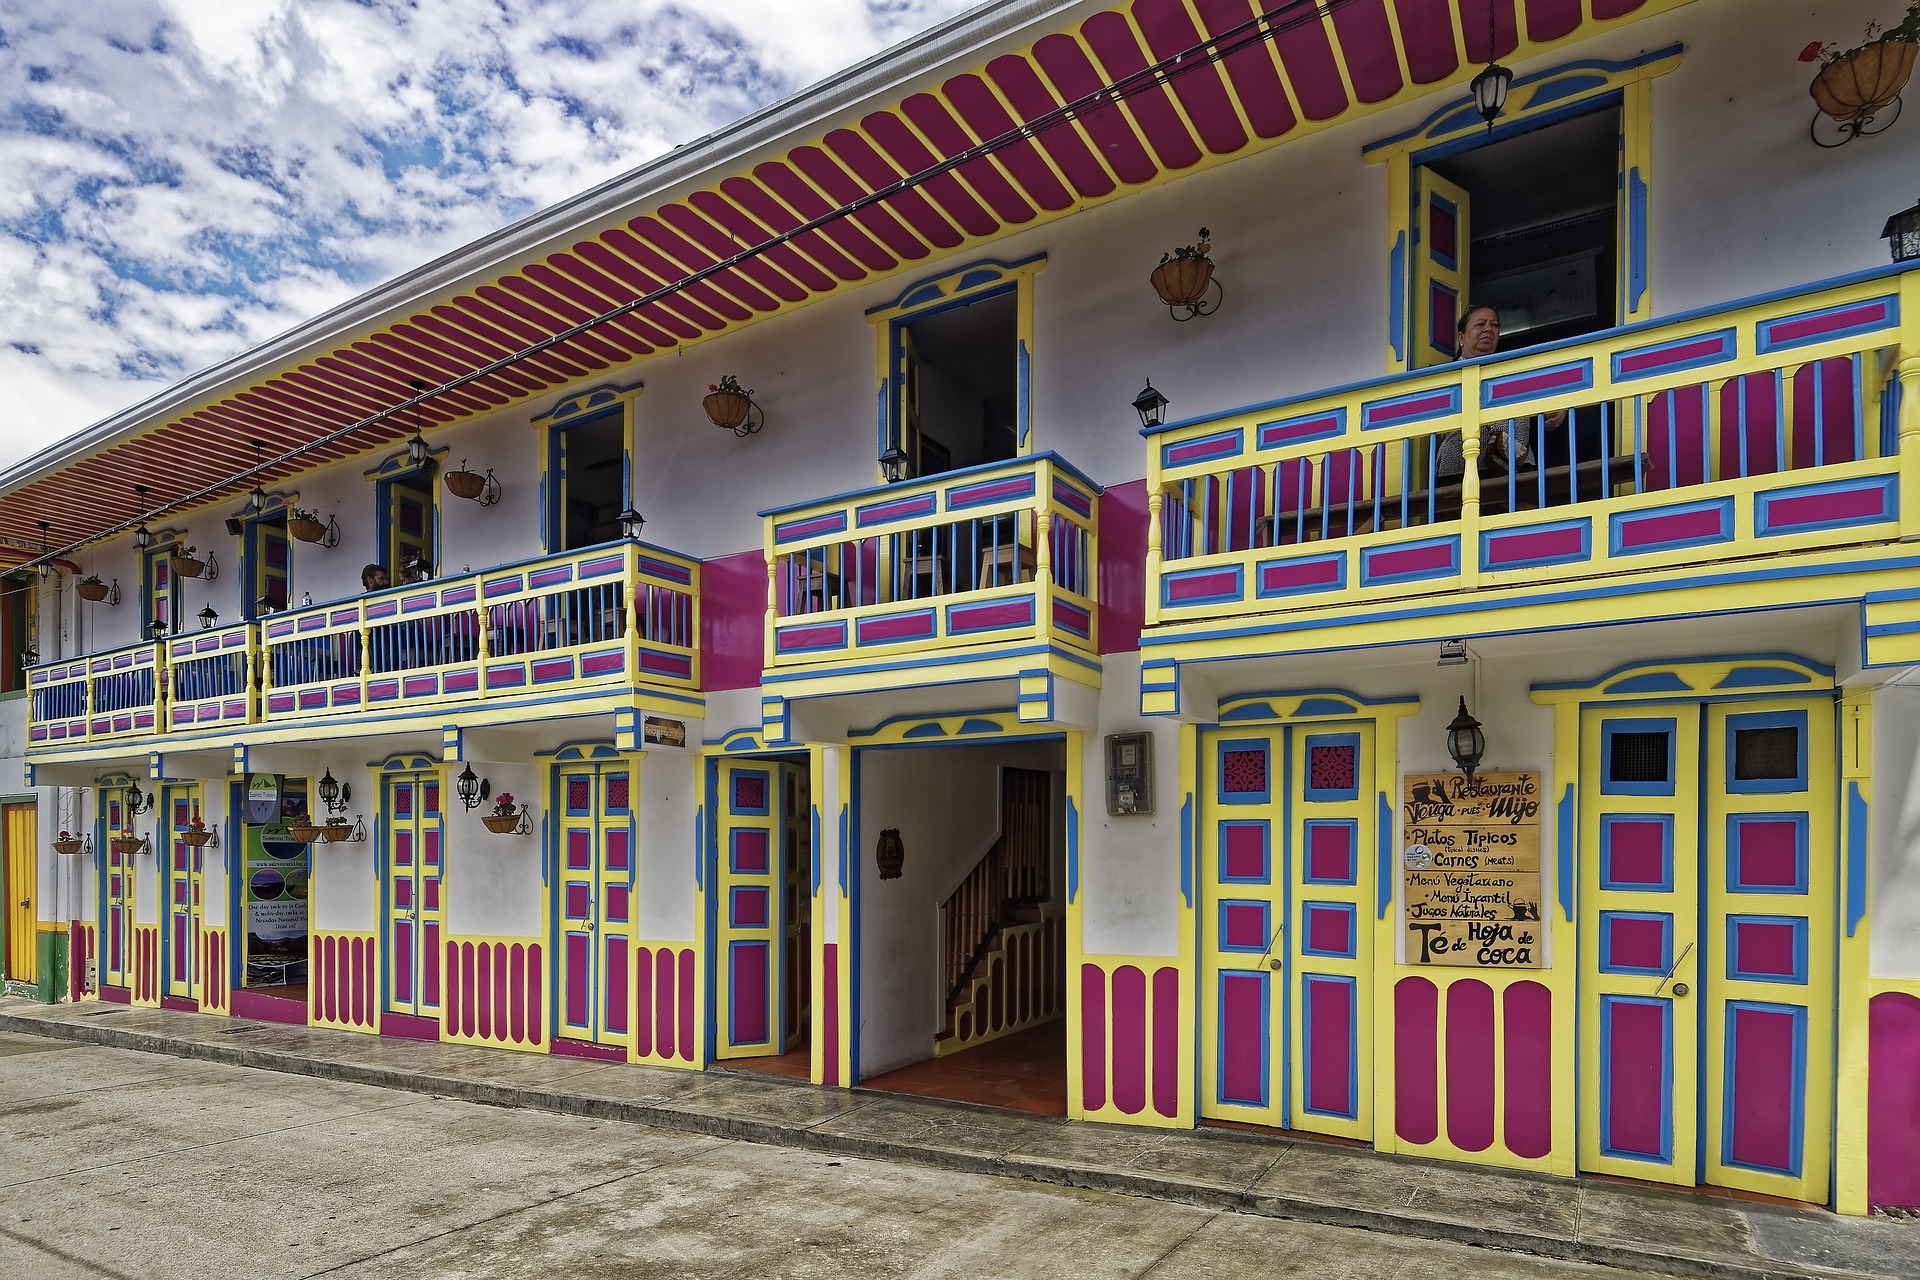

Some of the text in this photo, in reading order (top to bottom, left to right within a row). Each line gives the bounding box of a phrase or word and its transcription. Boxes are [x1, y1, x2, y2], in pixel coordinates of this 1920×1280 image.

[1449, 774, 1537, 800] Restaurante
[1460, 807, 1480, 816] PUES
[1411, 829, 1455, 846] Platos
[1434, 852, 1479, 869] Carnes
[1443, 872, 1514, 893] Vegetariano
[1449, 904, 1498, 920] Naturales
[1408, 922, 1534, 963] Té de Hoja de
